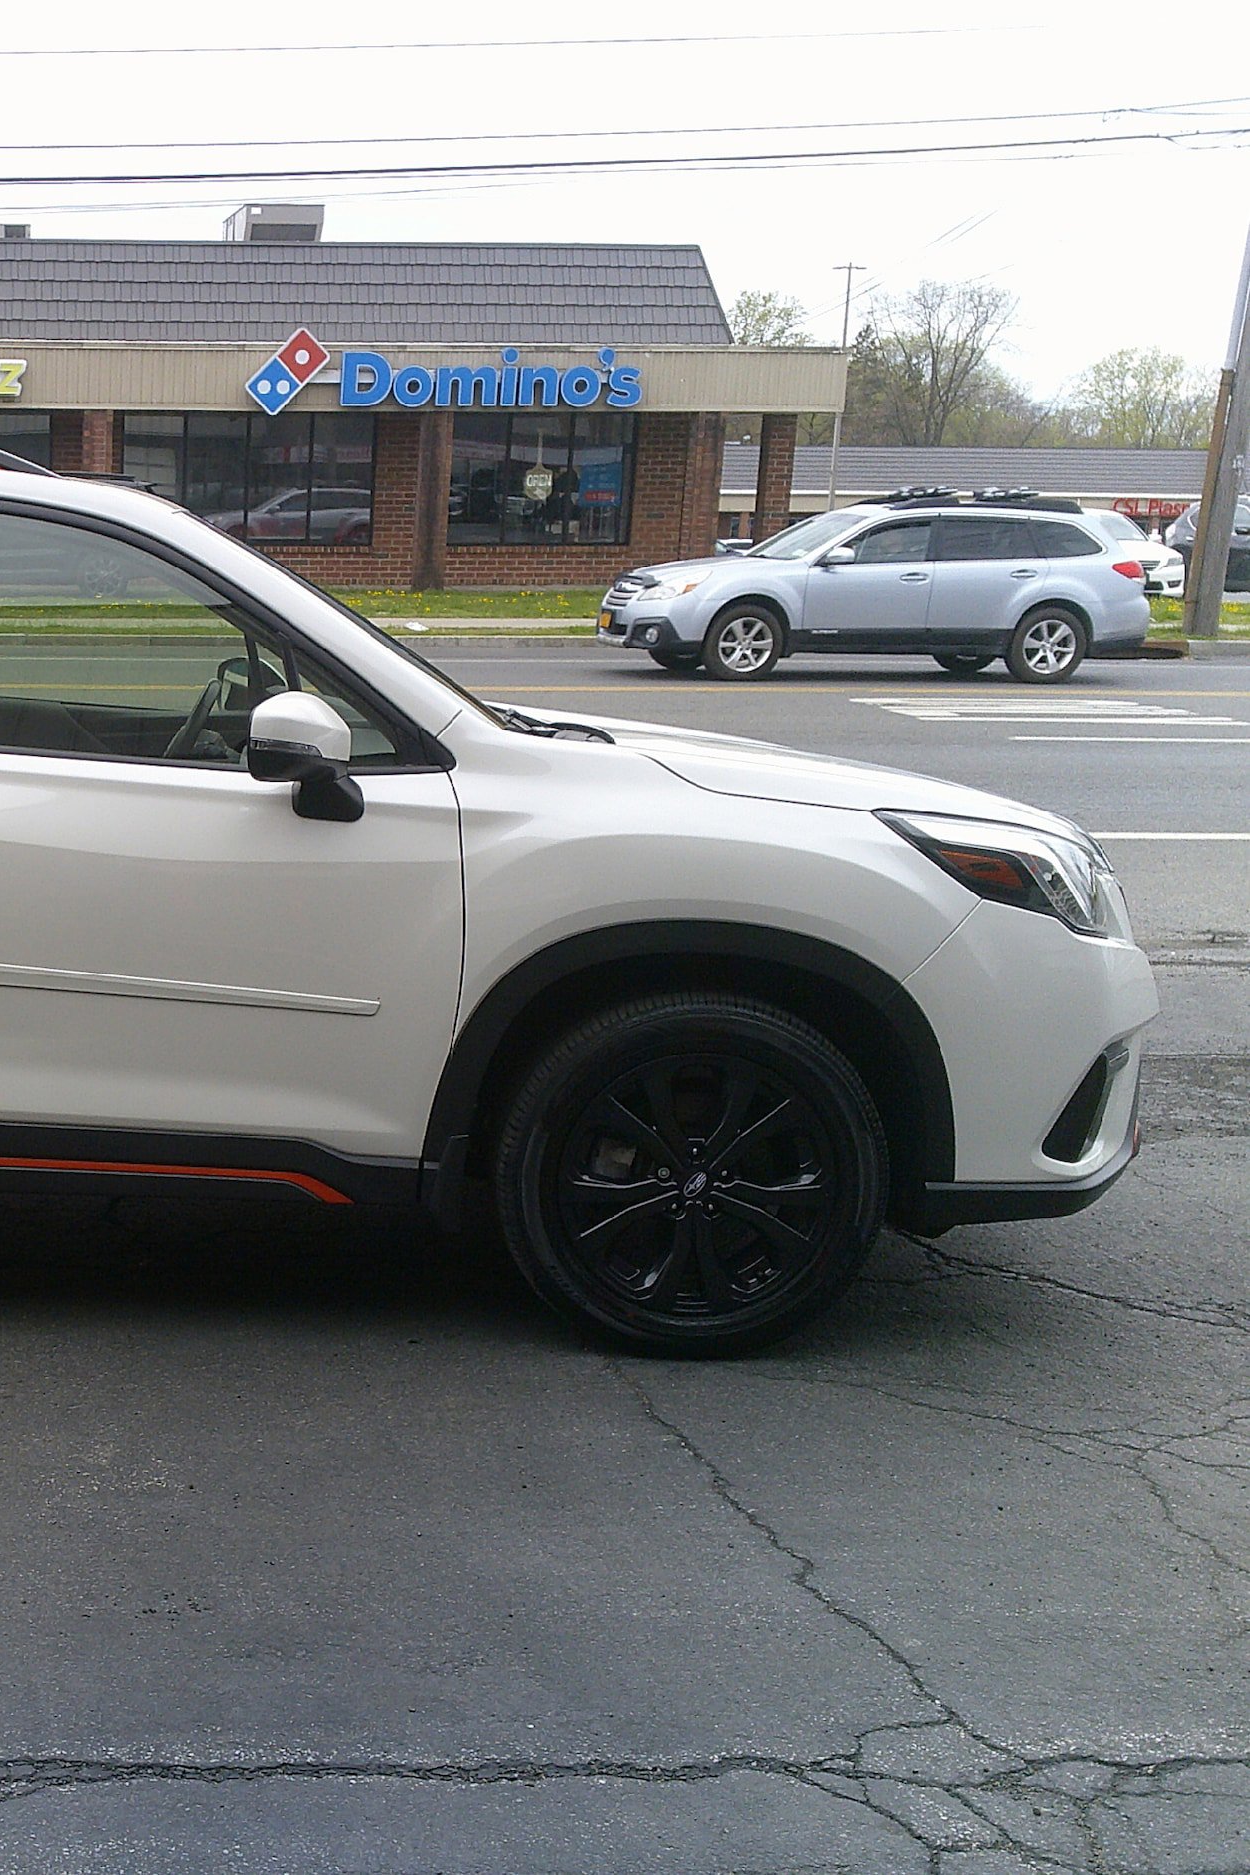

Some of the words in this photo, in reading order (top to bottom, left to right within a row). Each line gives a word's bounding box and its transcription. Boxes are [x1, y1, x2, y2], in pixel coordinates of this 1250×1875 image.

[339, 346, 643, 408] Domino's
[526, 473, 552, 487] OPEN
[1112, 497, 1142, 516] CSL
